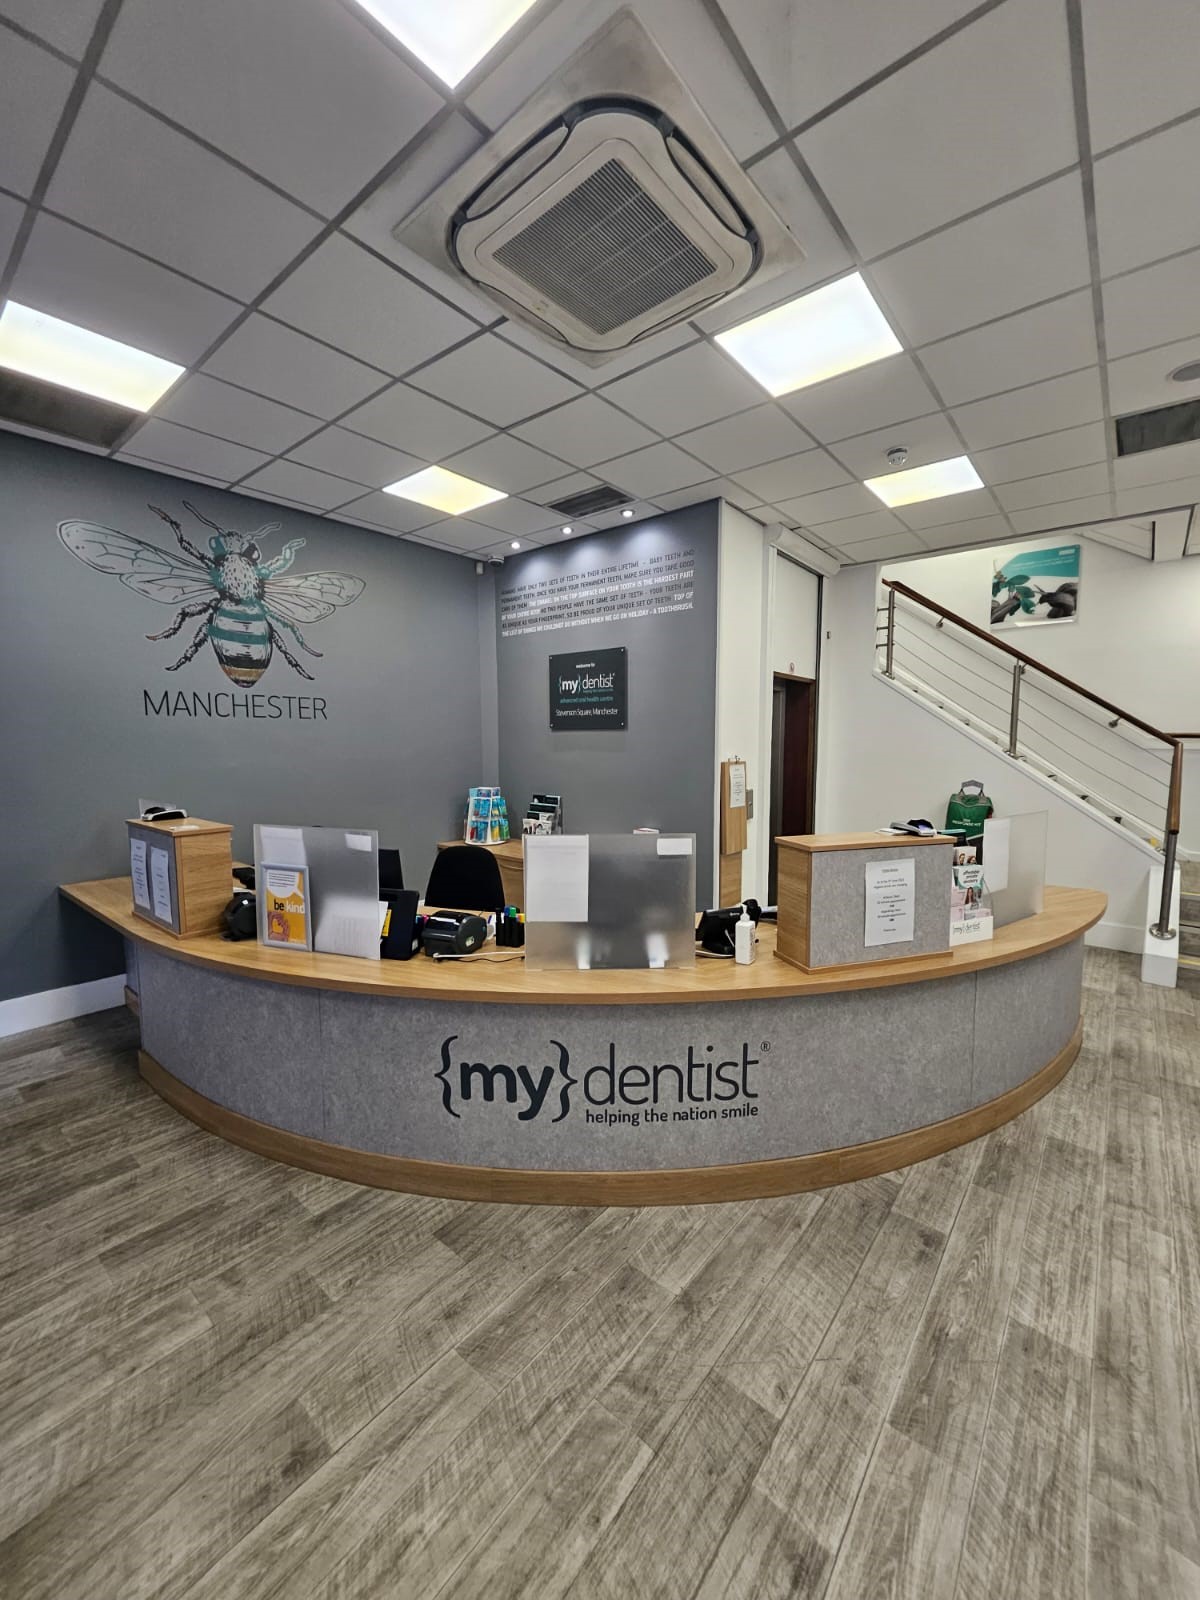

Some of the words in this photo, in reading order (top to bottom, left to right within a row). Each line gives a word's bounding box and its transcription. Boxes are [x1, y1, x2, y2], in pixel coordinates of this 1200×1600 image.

[618, 560, 638, 571] LIFETIME
[664, 552, 680, 561] TEETH
[638, 568, 650, 576] SURE
[653, 566, 663, 574] YOU
[654, 573, 678, 583] HARDEST
[680, 570, 693, 578] PART
[144, 690, 328, 720] MANCHESTER
[274, 899, 284, 910] be
[286, 901, 304, 914] kind
[586, 1109, 640, 1126] helping
[644, 1108, 668, 1122] the
[672, 1108, 716, 1121] nation
[721, 1102, 758, 1119] smile
